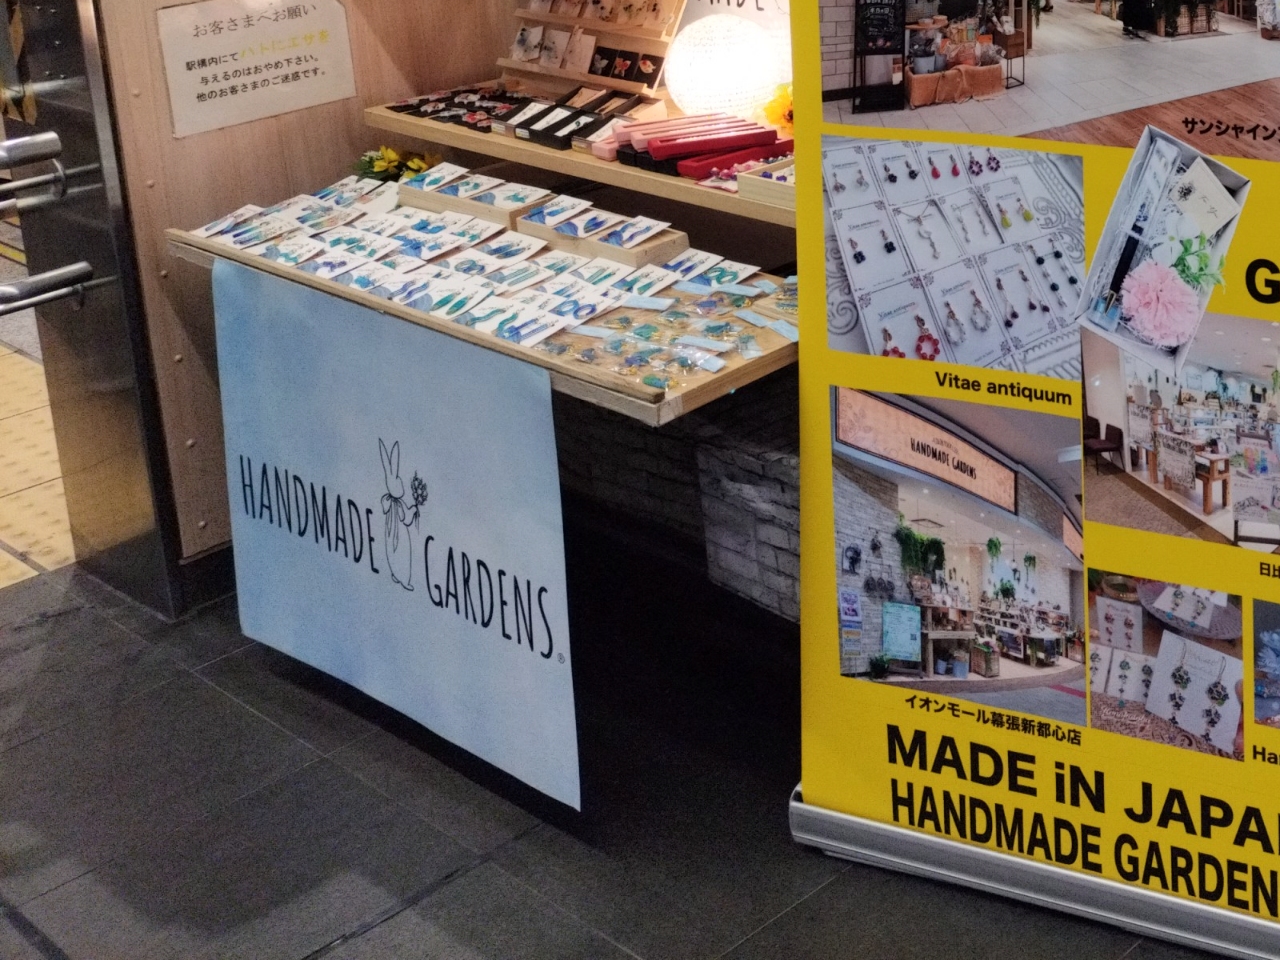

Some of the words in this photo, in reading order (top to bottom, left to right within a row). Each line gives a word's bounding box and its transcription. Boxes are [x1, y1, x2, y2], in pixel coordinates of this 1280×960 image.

[193, 3, 318, 38] お客さまへお願い
[934, 370, 982, 396] Vitae
[986, 380, 1073, 406] antiquum
[910, 437, 950, 467] HANDMADE
[952, 456, 977, 480] GARDENS
[239, 454, 380, 574] HANDMADE
[904, 695, 1082, 746] イオンモール幕張新都心店
[886, 724, 1039, 797] MADE
[1055, 761, 1106, 814] iN
[890, 778, 1103, 874] HANDMADE
